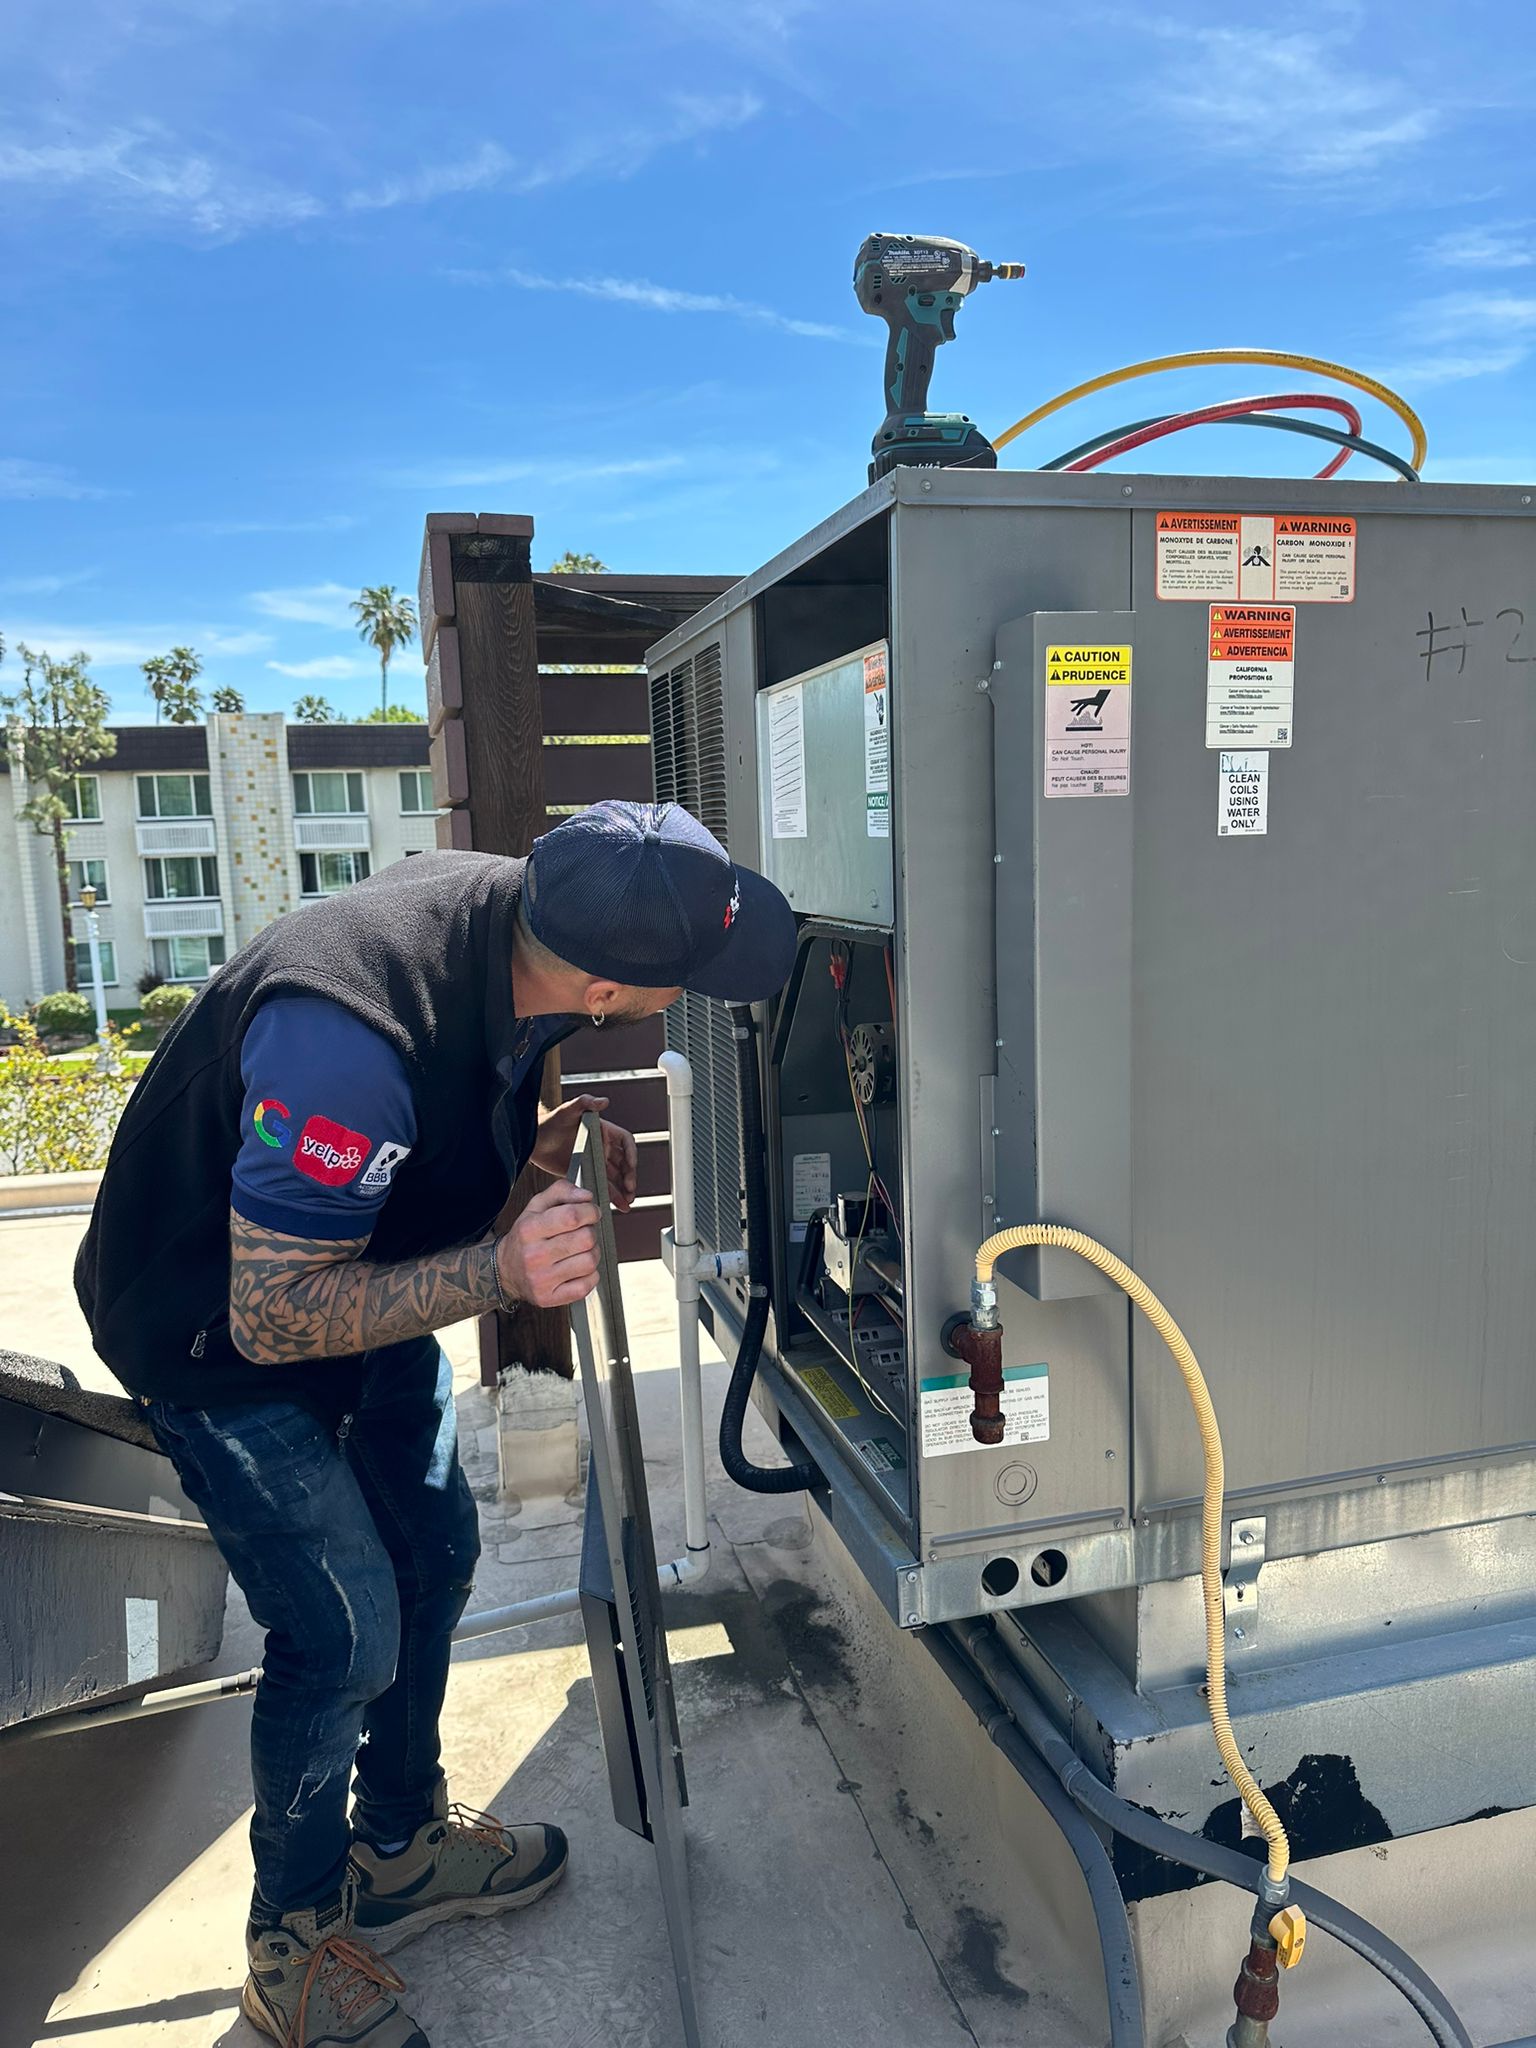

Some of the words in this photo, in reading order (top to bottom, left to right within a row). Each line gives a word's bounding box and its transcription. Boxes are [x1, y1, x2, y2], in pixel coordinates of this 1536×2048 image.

[1171, 518, 1238, 530] AVERTISSEMENT
[1290, 522, 1352, 534] WARNING
[1224, 610, 1291, 622] WARNING
[1223, 628, 1291, 639] AVERTISSEMENT
[1226, 645, 1288, 656] ADVERTENCIA
[1064, 651, 1120, 662] CAUTION
[1062, 670, 1126, 681] PRUDENCE
[1228, 773, 1261, 784] CLEAN
[1230, 785, 1259, 795] COILS
[1229, 796, 1259, 806] USING
[1227, 807, 1260, 818] WATER
[1230, 819, 1256, 829] ONLY
[303, 1136, 342, 1169] yelp
[365, 1172, 388, 1183] BBB
